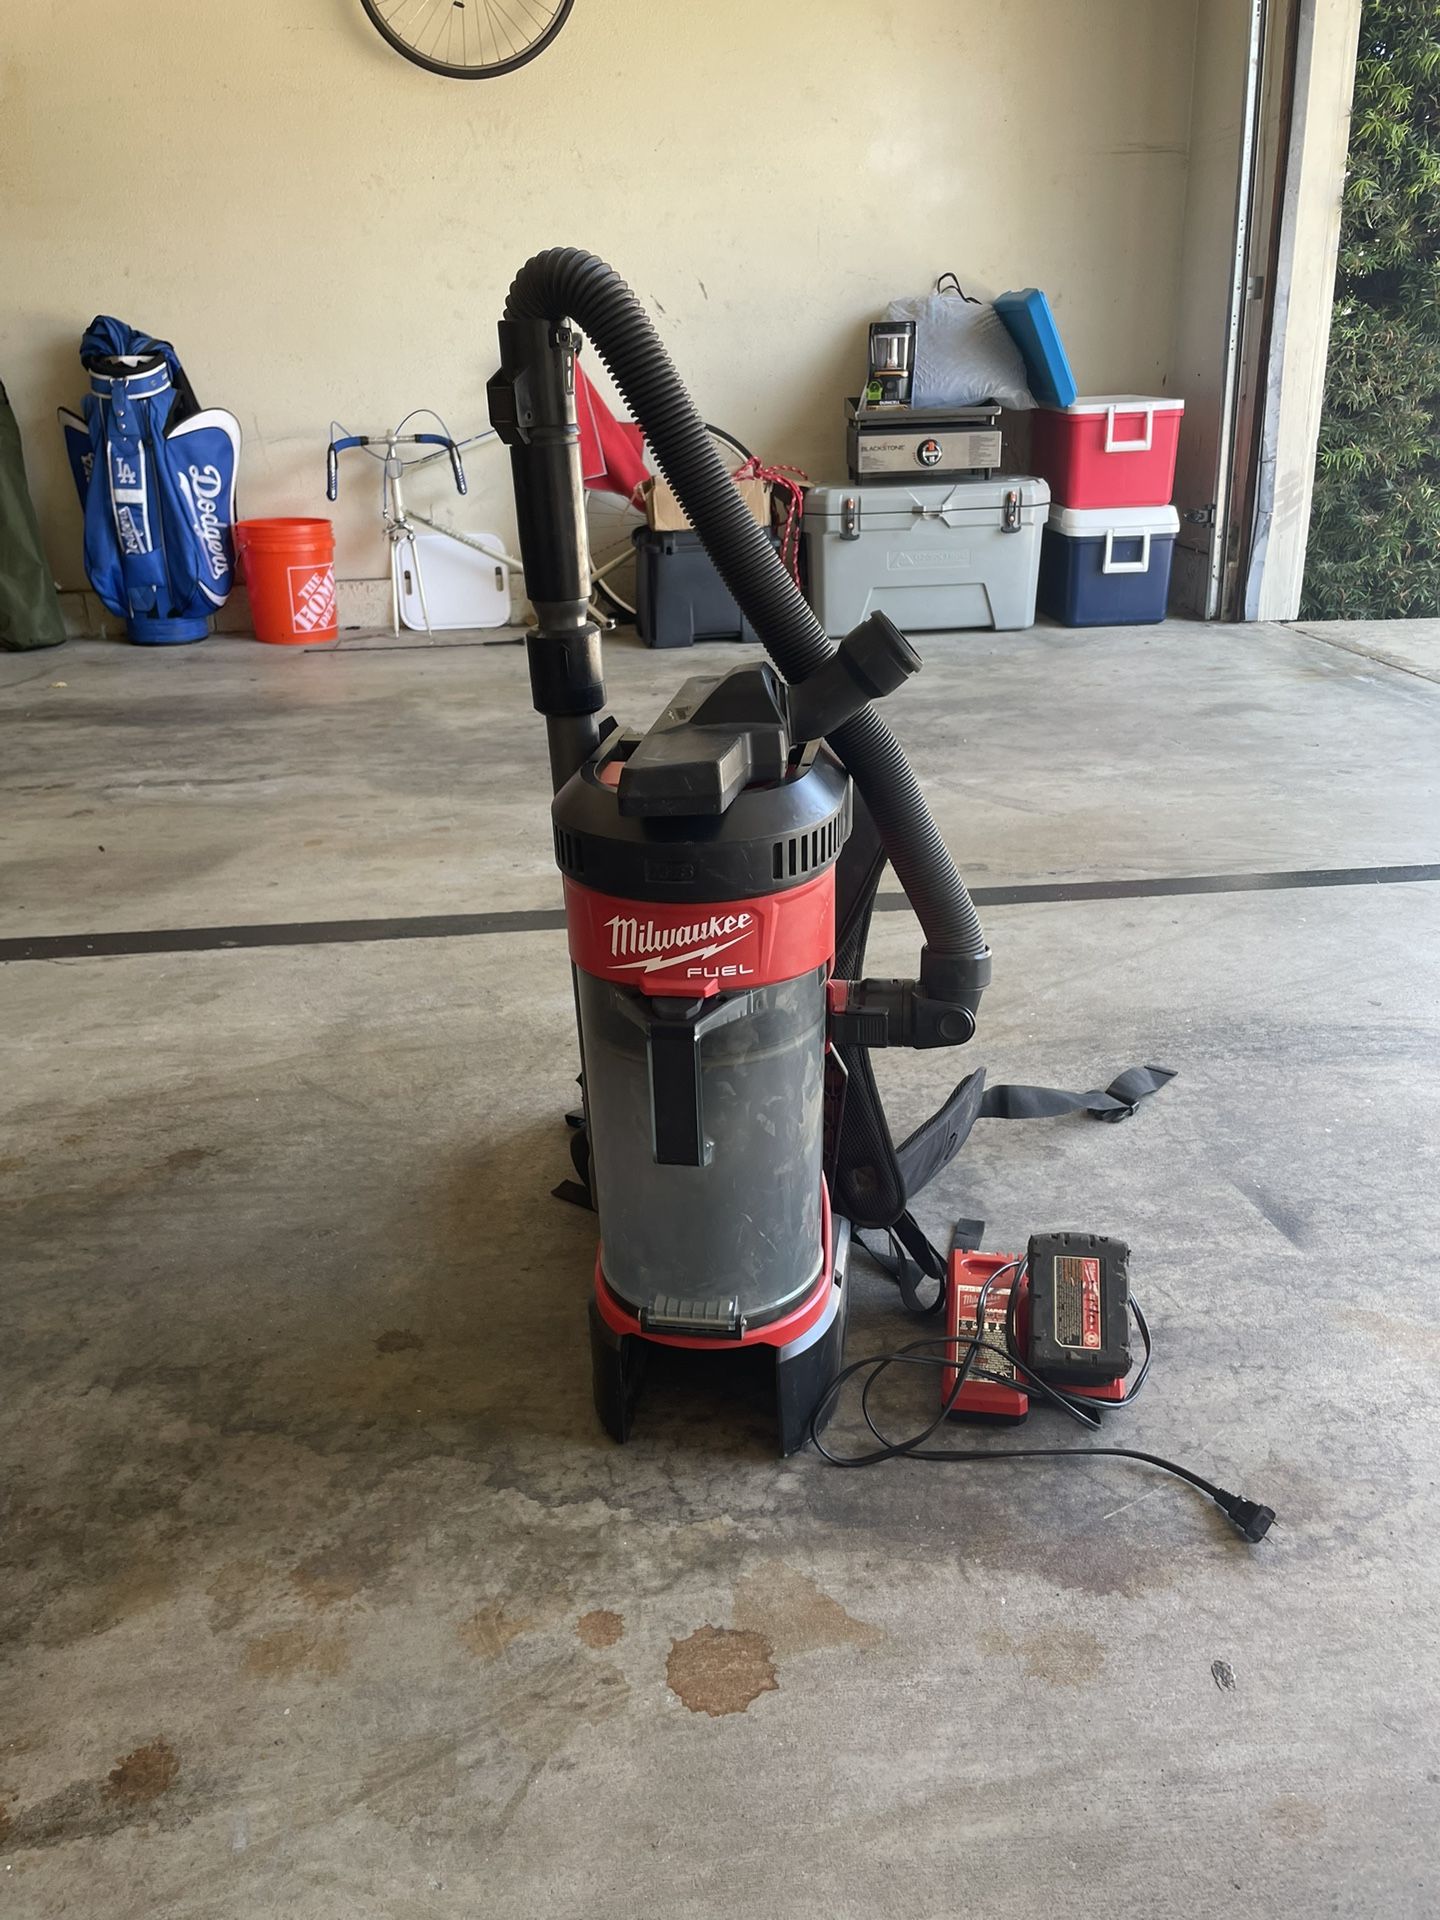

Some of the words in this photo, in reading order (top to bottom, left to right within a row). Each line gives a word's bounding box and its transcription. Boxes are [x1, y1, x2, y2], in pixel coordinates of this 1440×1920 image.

[861, 443, 905, 453] BLACKSTONE
[116, 457, 136, 484] LA
[178, 464, 229, 580] Dodgers
[294, 567, 336, 631] HOM
[298, 572, 323, 600] THE
[603, 912, 753, 957] Milwaukee
[687, 965, 754, 978] FUEL
